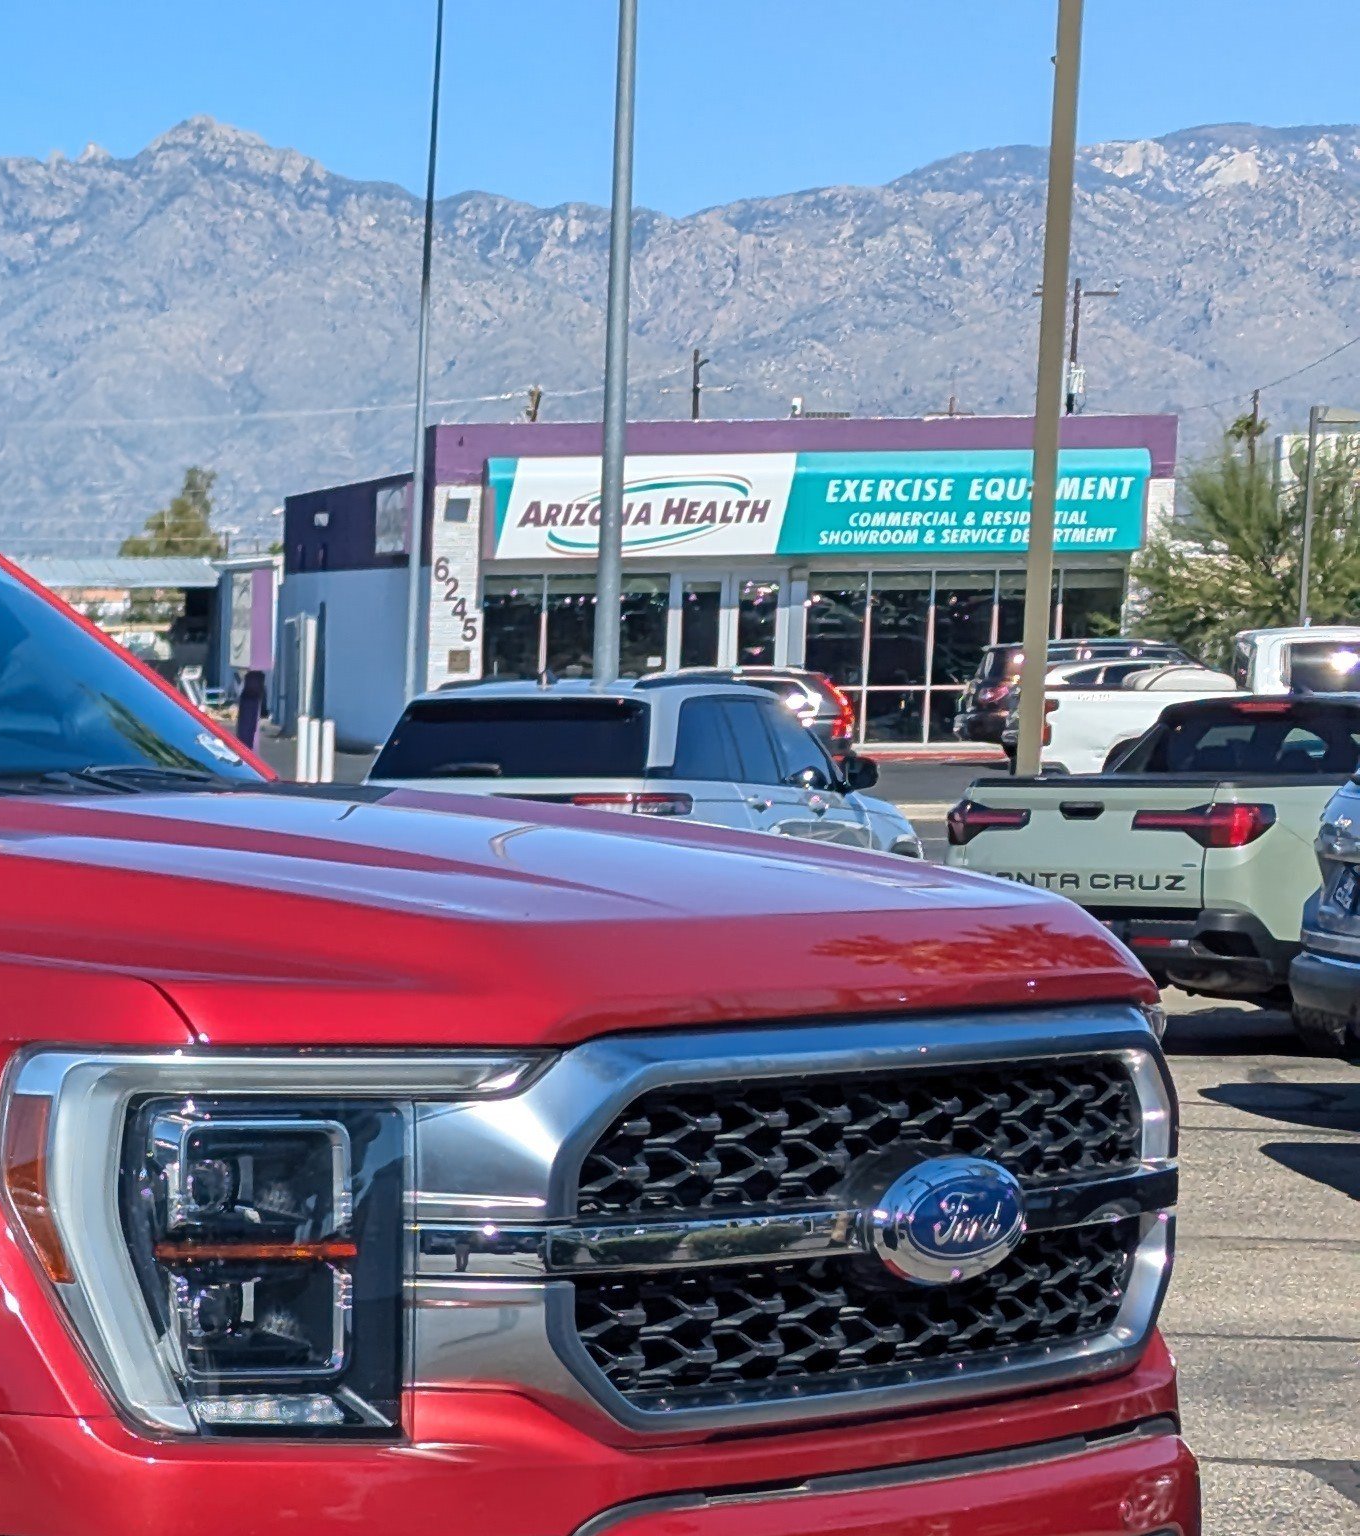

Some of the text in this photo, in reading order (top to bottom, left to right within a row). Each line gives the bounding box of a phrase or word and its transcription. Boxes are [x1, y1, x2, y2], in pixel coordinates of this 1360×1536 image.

[826, 477, 1136, 503] EXERCISE EQUMENT
[661, 498, 772, 525] HEALTH
[848, 511, 1088, 528] COMMERCIAL & RESIDTIAL
[818, 527, 1118, 546] SHOWROOM & SERVICE DERTMENT
[433, 556, 478, 643] 6245
[1089, 872, 1186, 891] CRUZ
[933, 1190, 1004, 1247] Ford
